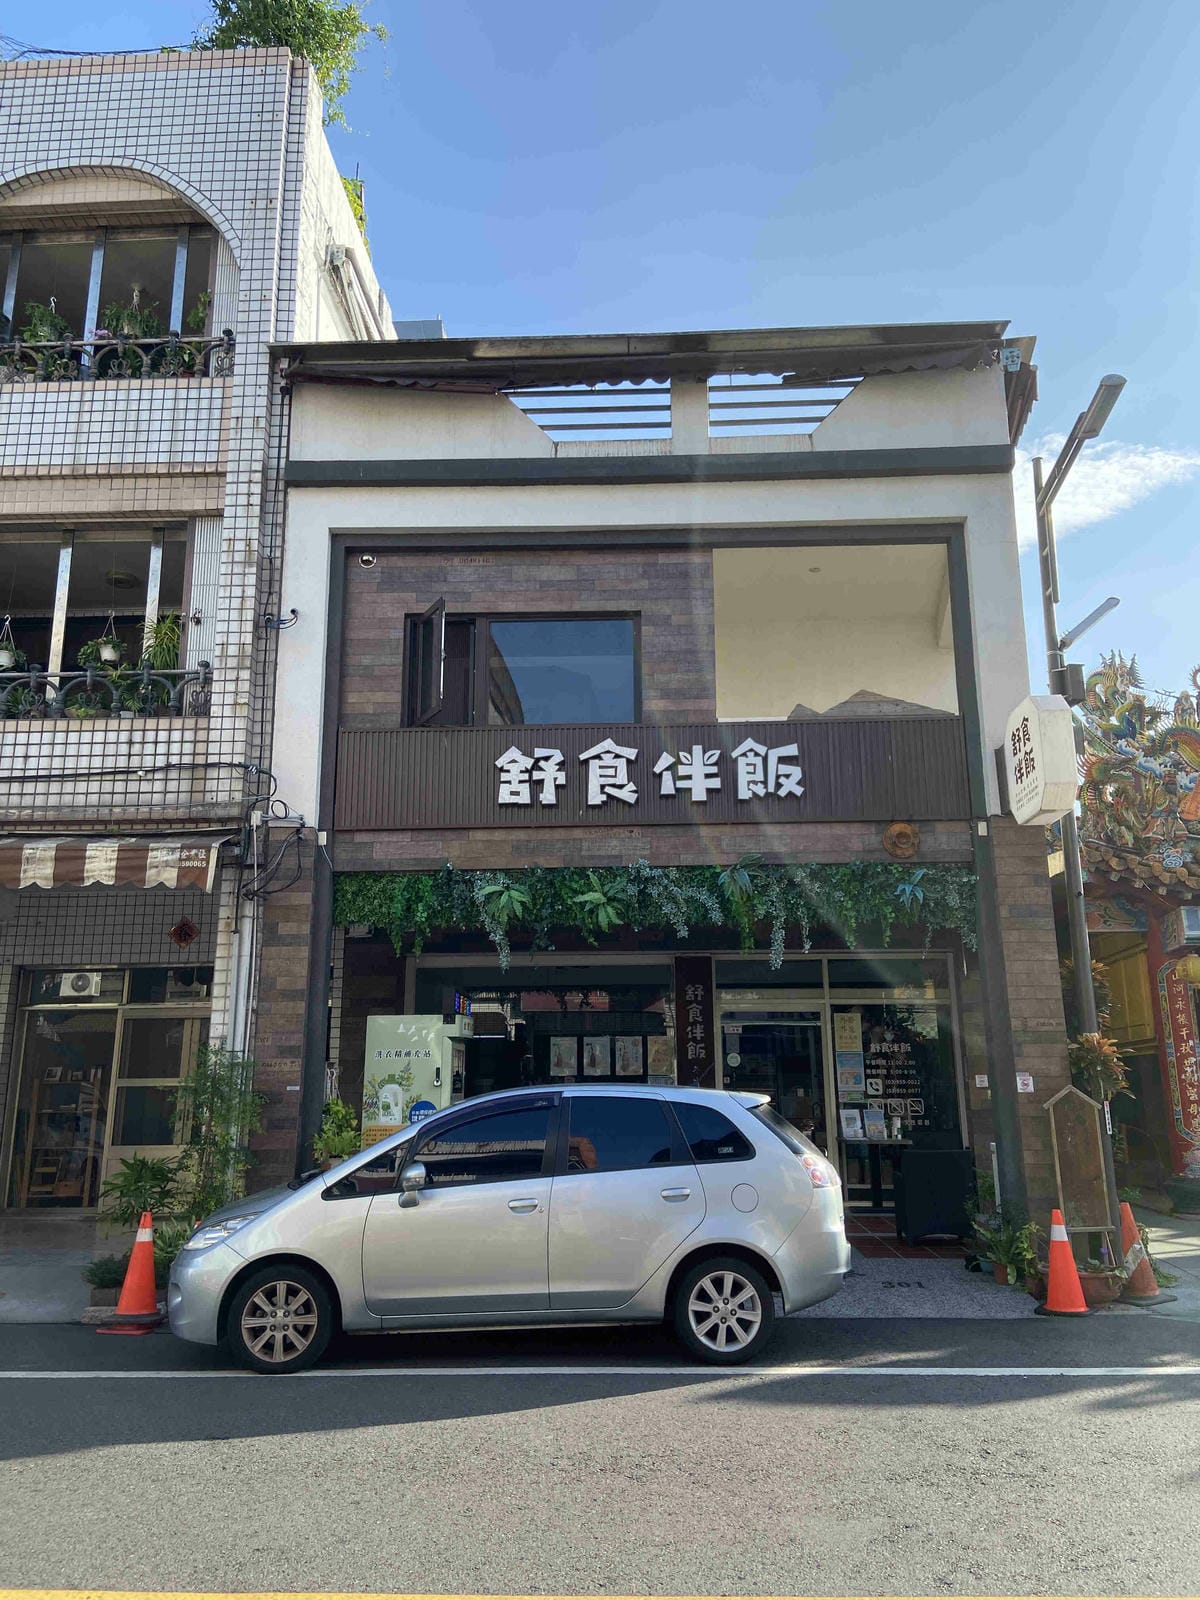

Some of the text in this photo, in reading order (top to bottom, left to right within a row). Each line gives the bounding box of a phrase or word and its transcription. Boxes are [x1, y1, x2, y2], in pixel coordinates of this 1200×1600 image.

[1011, 716, 1031, 757] 舒食
[494, 737, 805, 805] 舒食伴飯
[685, 984, 706, 1060] 舒食伴飯
[870, 1042, 912, 1053] 舒食伴飯
